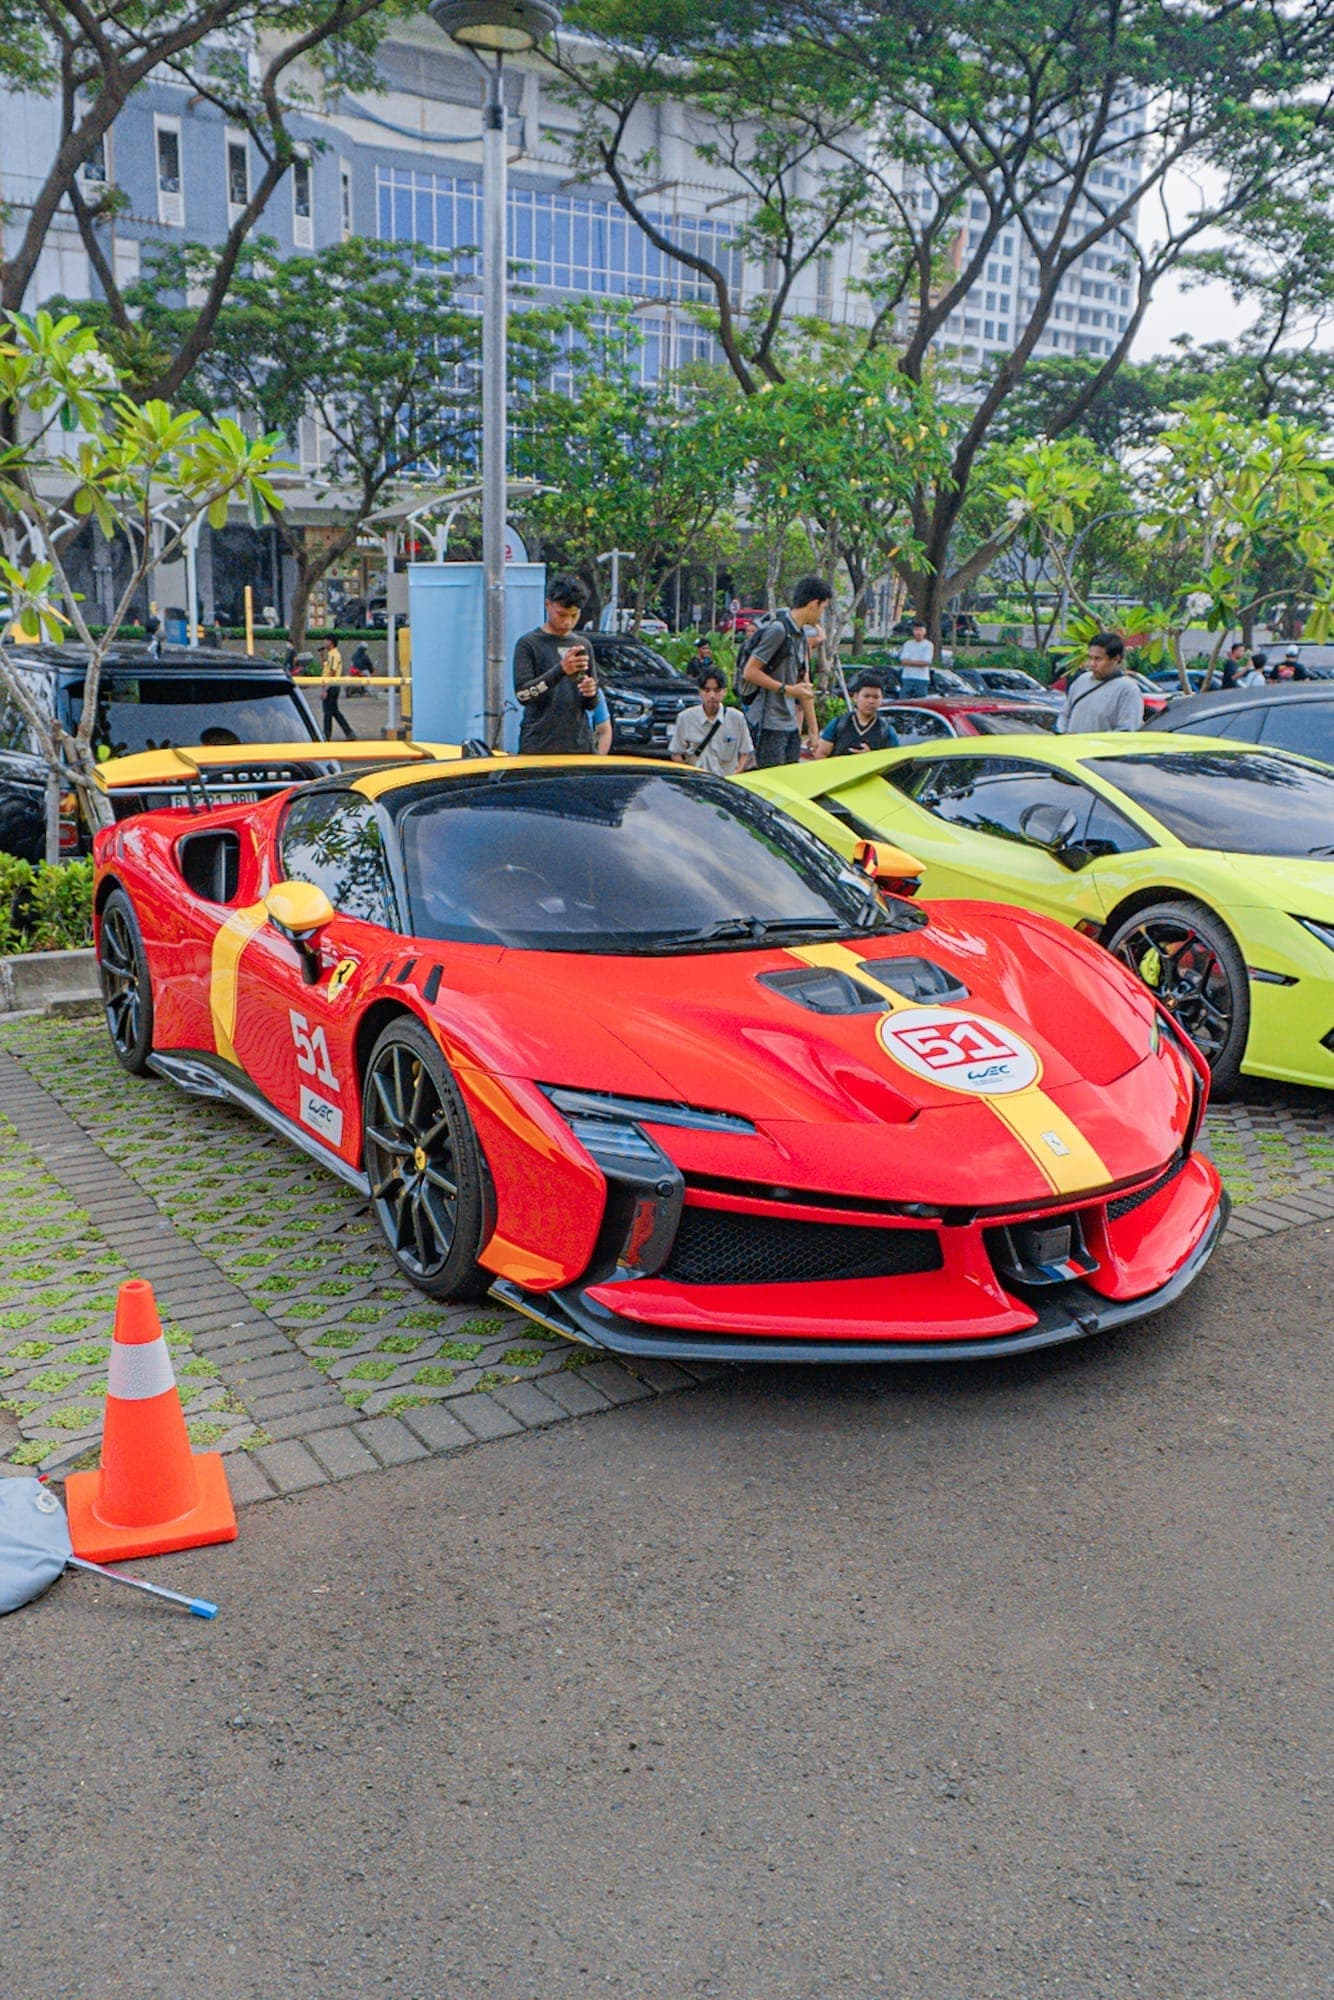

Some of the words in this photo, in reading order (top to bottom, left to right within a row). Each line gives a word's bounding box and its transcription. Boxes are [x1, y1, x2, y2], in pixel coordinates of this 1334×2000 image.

[222, 771, 292, 783] ROVER
[289, 1008, 341, 1093] 51
[896, 1023, 1016, 1066] 51
[968, 1065, 1010, 1080] WEC
[308, 1099, 334, 1122] WEC
